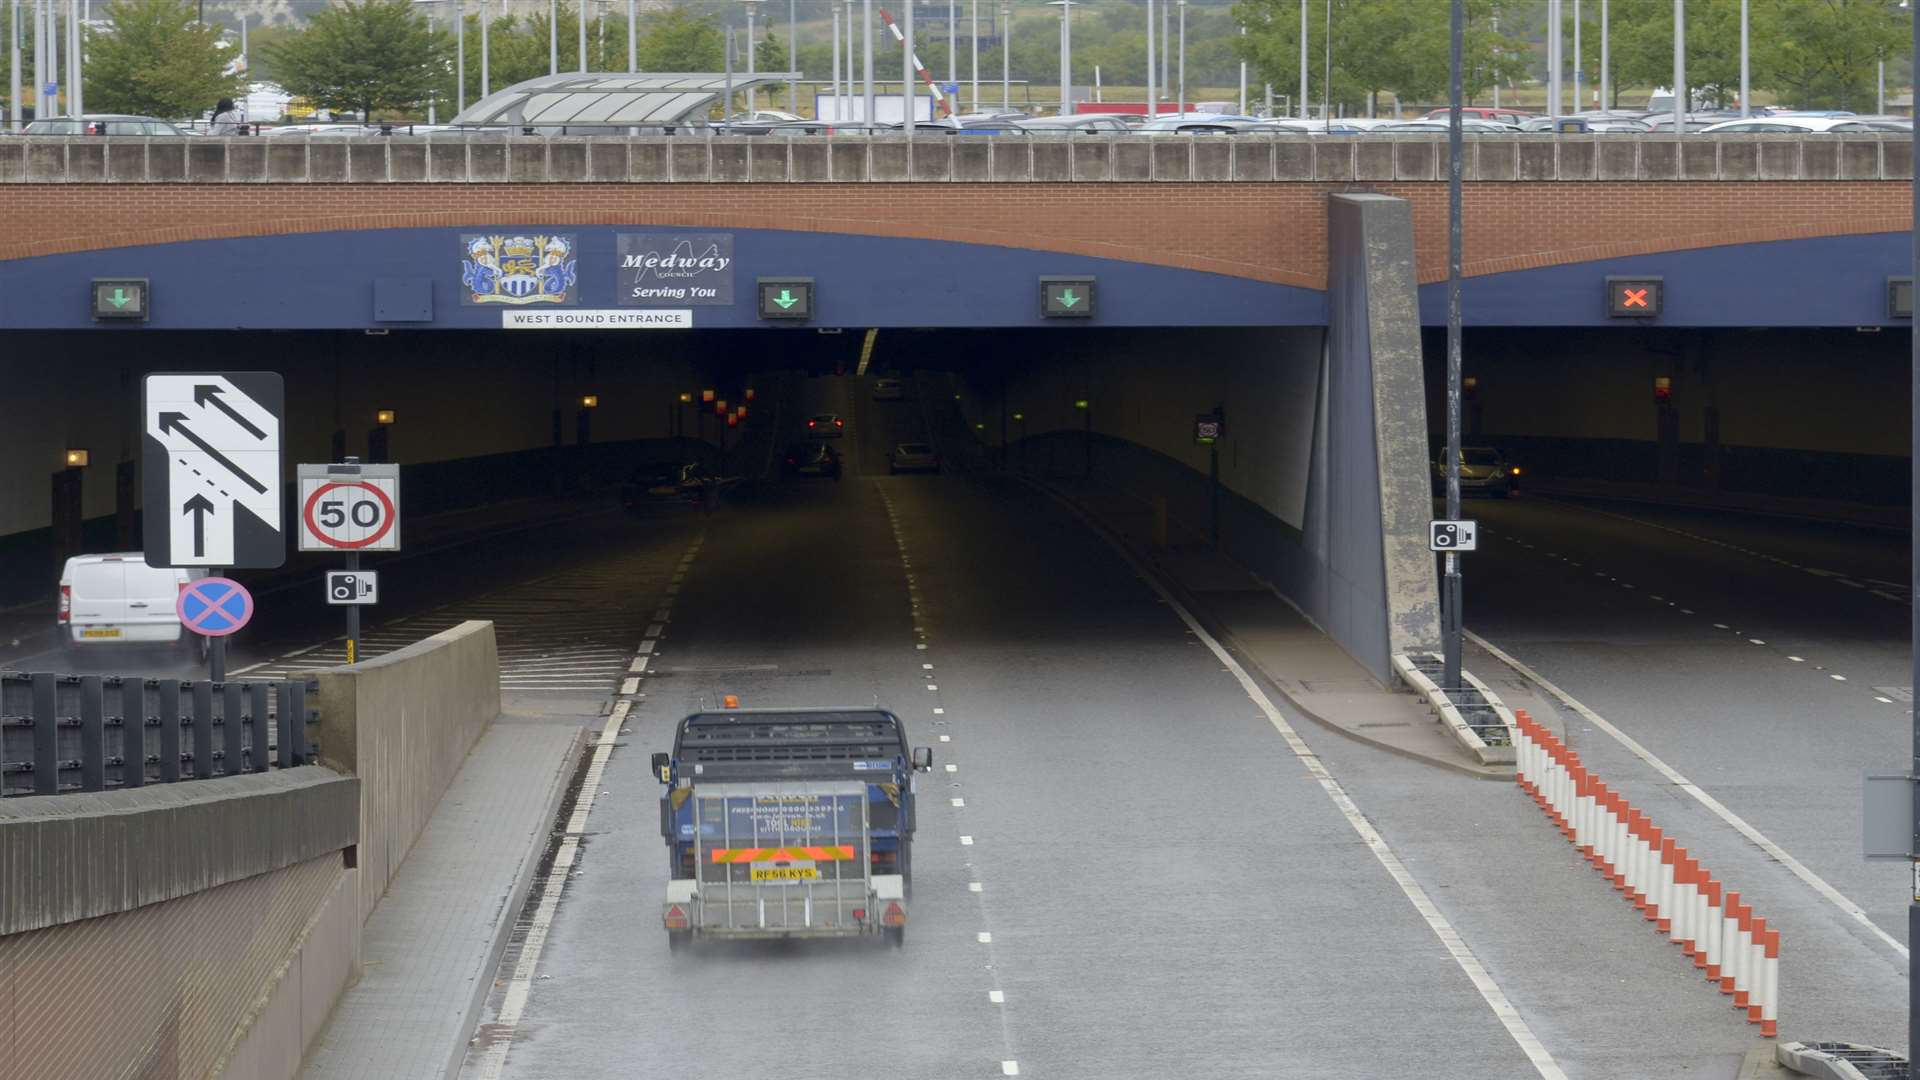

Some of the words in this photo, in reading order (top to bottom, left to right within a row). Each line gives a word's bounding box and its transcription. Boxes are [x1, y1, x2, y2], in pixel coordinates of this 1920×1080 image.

[621, 254, 730, 271] Medway
[632, 286, 685, 298] Serving
[690, 286, 716, 297] You
[514, 315, 549, 323] WEST
[556, 315, 604, 323] BOUND
[610, 314, 682, 323] ENTRANCE
[321, 500, 380, 528] 50
